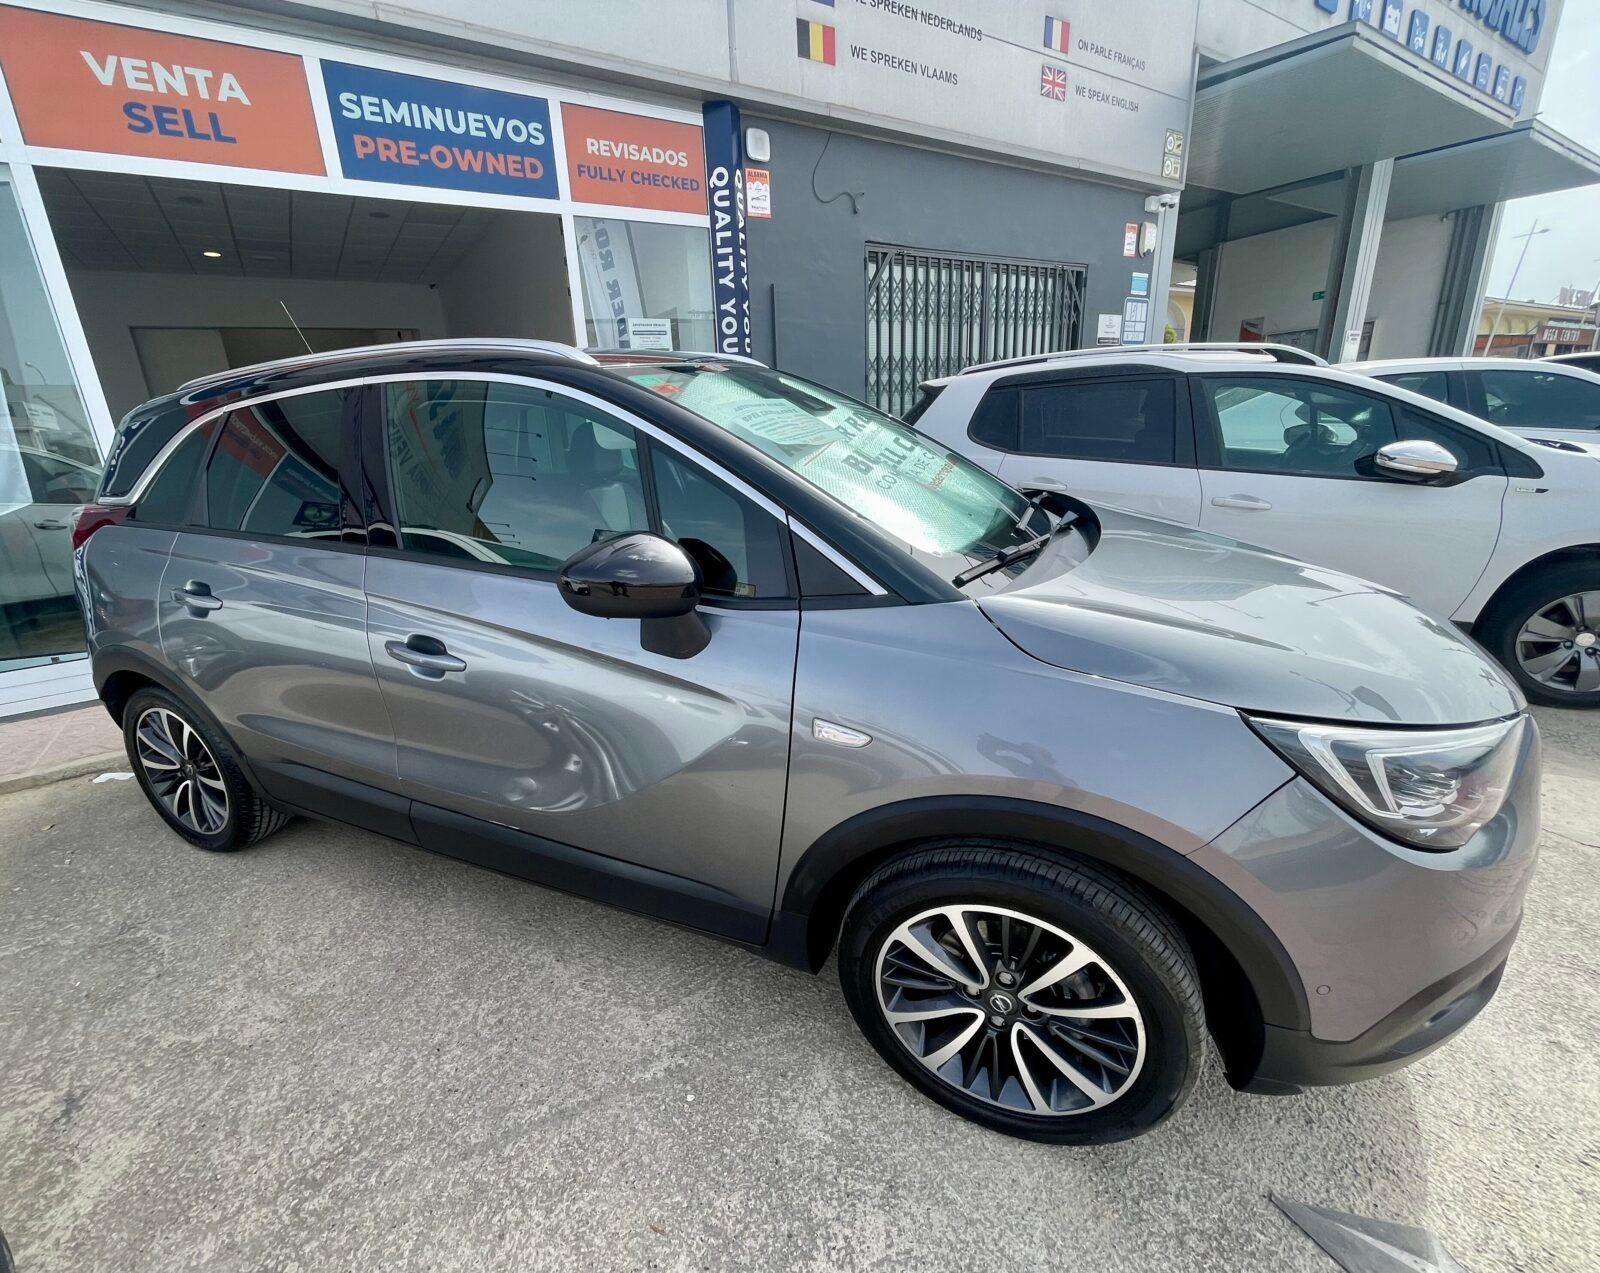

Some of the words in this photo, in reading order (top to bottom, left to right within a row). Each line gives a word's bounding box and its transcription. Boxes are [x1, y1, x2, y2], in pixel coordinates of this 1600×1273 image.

[920, 10, 983, 41] NEDERLANDS
[850, 44, 867, 61] WE
[870, 50, 918, 75] SPREKEN
[920, 63, 958, 85] VLAAMS
[1078, 39, 1088, 52] ON
[1090, 42, 1112, 60] PARLE
[1113, 51, 1146, 71] FRANÇAIS
[79, 50, 251, 106] VENTA
[1075, 84, 1086, 98] WE
[1088, 88, 1110, 104] SPEAK
[1111, 96, 1139, 112] ENGLISH
[122, 101, 237, 144] SELL
[339, 91, 546, 146] SEMINUEVOS
[352, 134, 544, 180] PRE-OWNED
[586, 137, 688, 168] REVISADOS
[577, 164, 626, 182] FULLY
[630, 171, 700, 192] CHECKED
[709, 166, 735, 289] QUALITY
[735, 168, 748, 291] QUALITY
[720, 297, 739, 354] YOU
